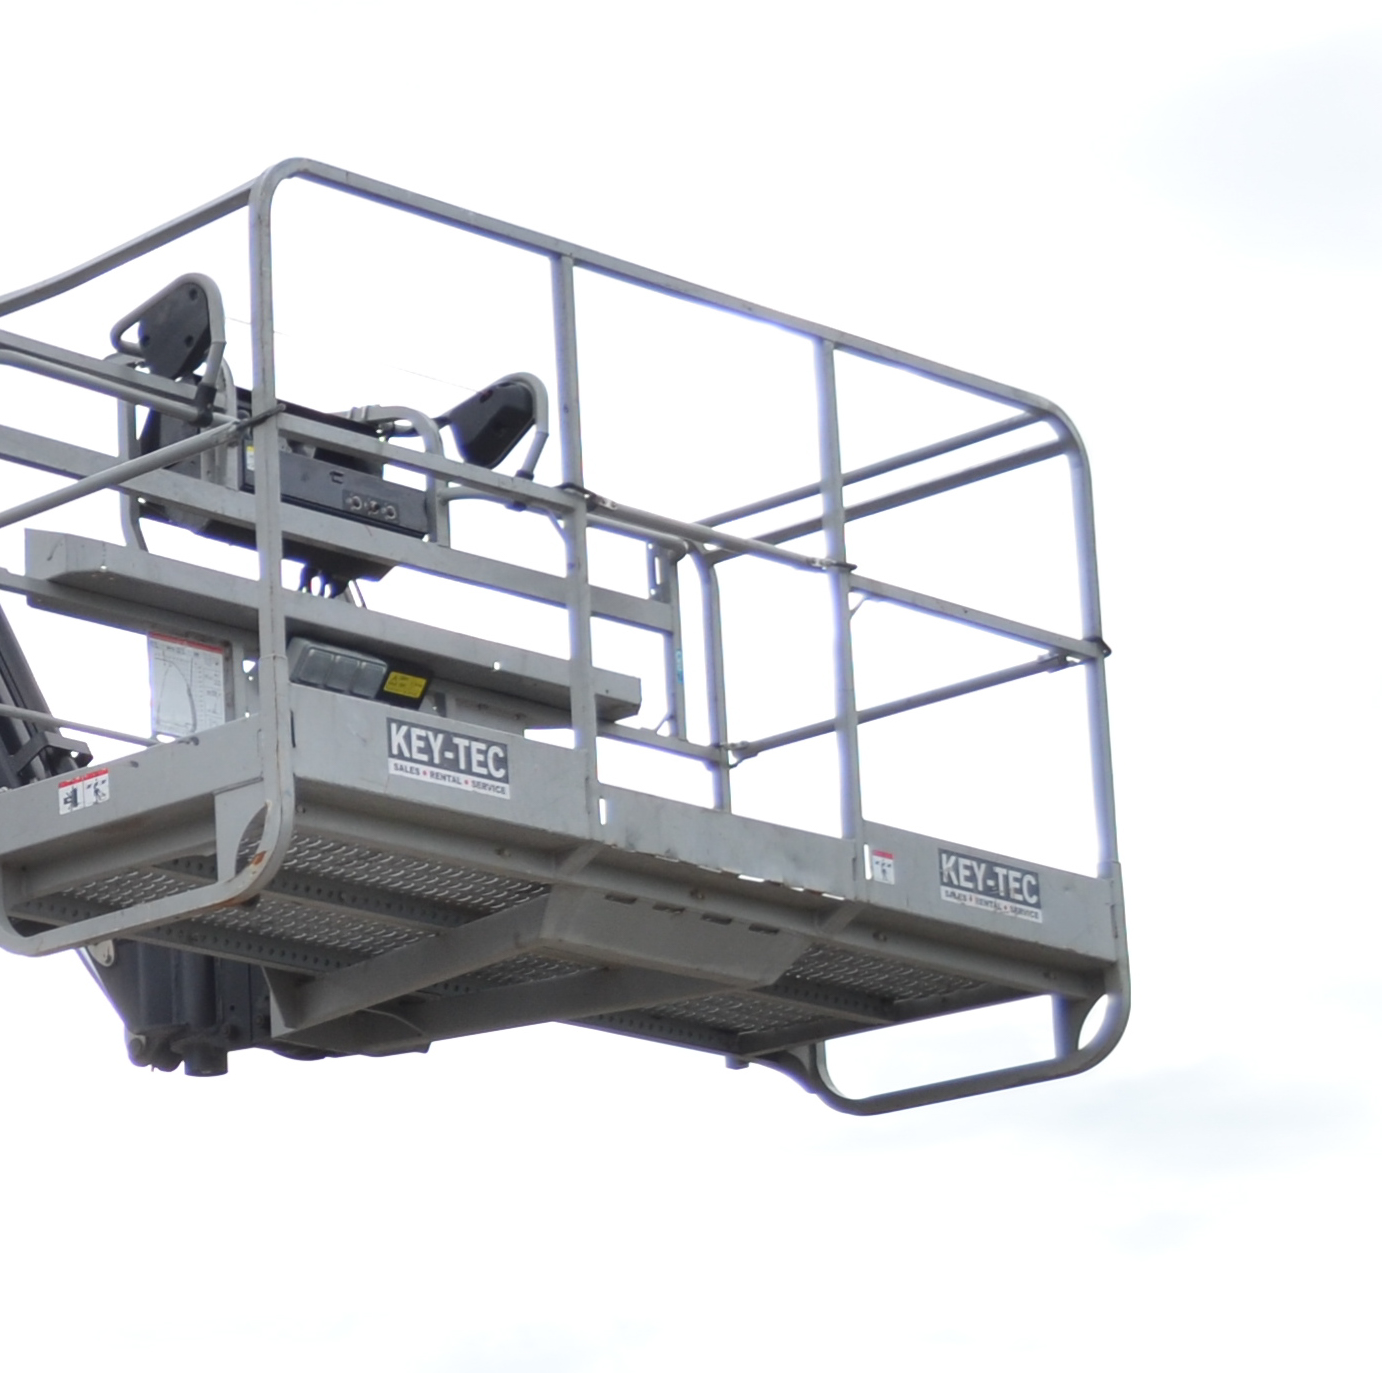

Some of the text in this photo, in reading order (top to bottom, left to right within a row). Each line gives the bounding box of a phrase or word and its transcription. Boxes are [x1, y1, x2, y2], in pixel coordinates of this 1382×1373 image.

[390, 722, 506, 778] KEY-TEC
[393, 762, 506, 795] SALES RENTAL SERVICE
[941, 853, 1039, 904] KEY-TEC
[975, 896, 1002, 911] RENTAL
